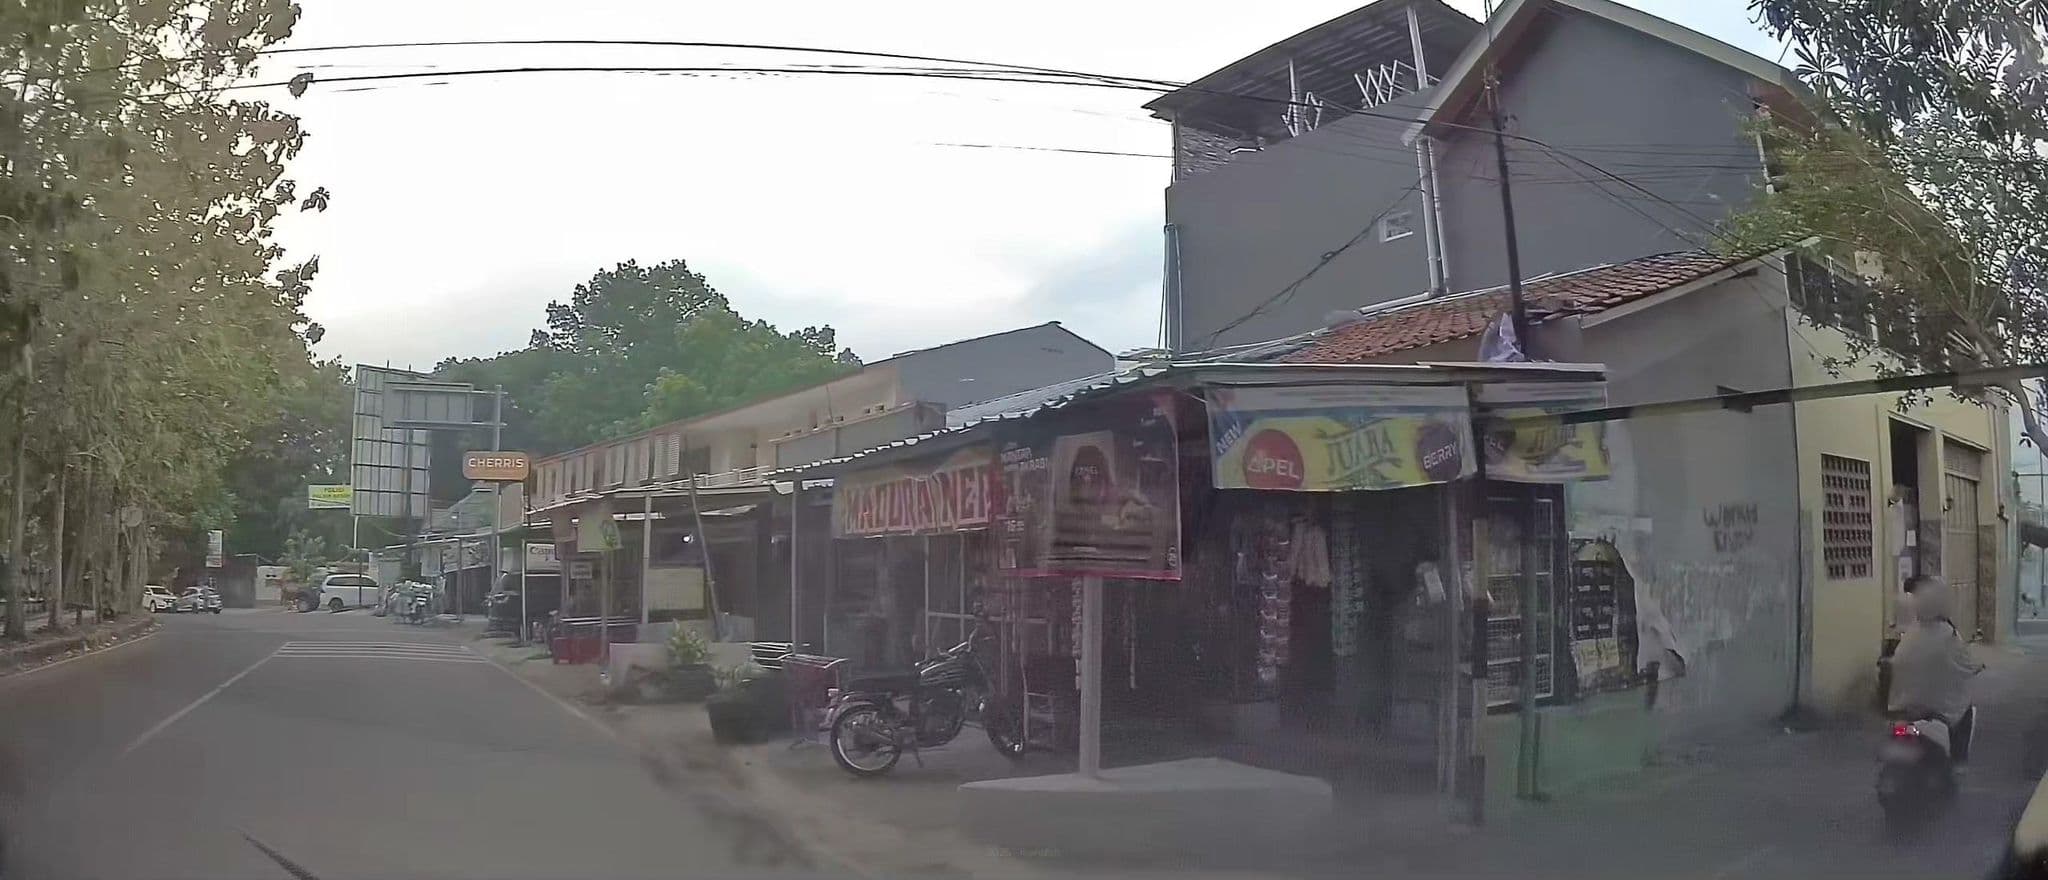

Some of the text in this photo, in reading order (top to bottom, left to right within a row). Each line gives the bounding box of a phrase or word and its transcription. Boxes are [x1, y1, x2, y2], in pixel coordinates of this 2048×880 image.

[1216, 422, 1242, 454] NEW
[468, 458, 524, 468] CHERRIS
[1247, 455, 1300, 479] APEL
[1423, 443, 1457, 470] BERRY
